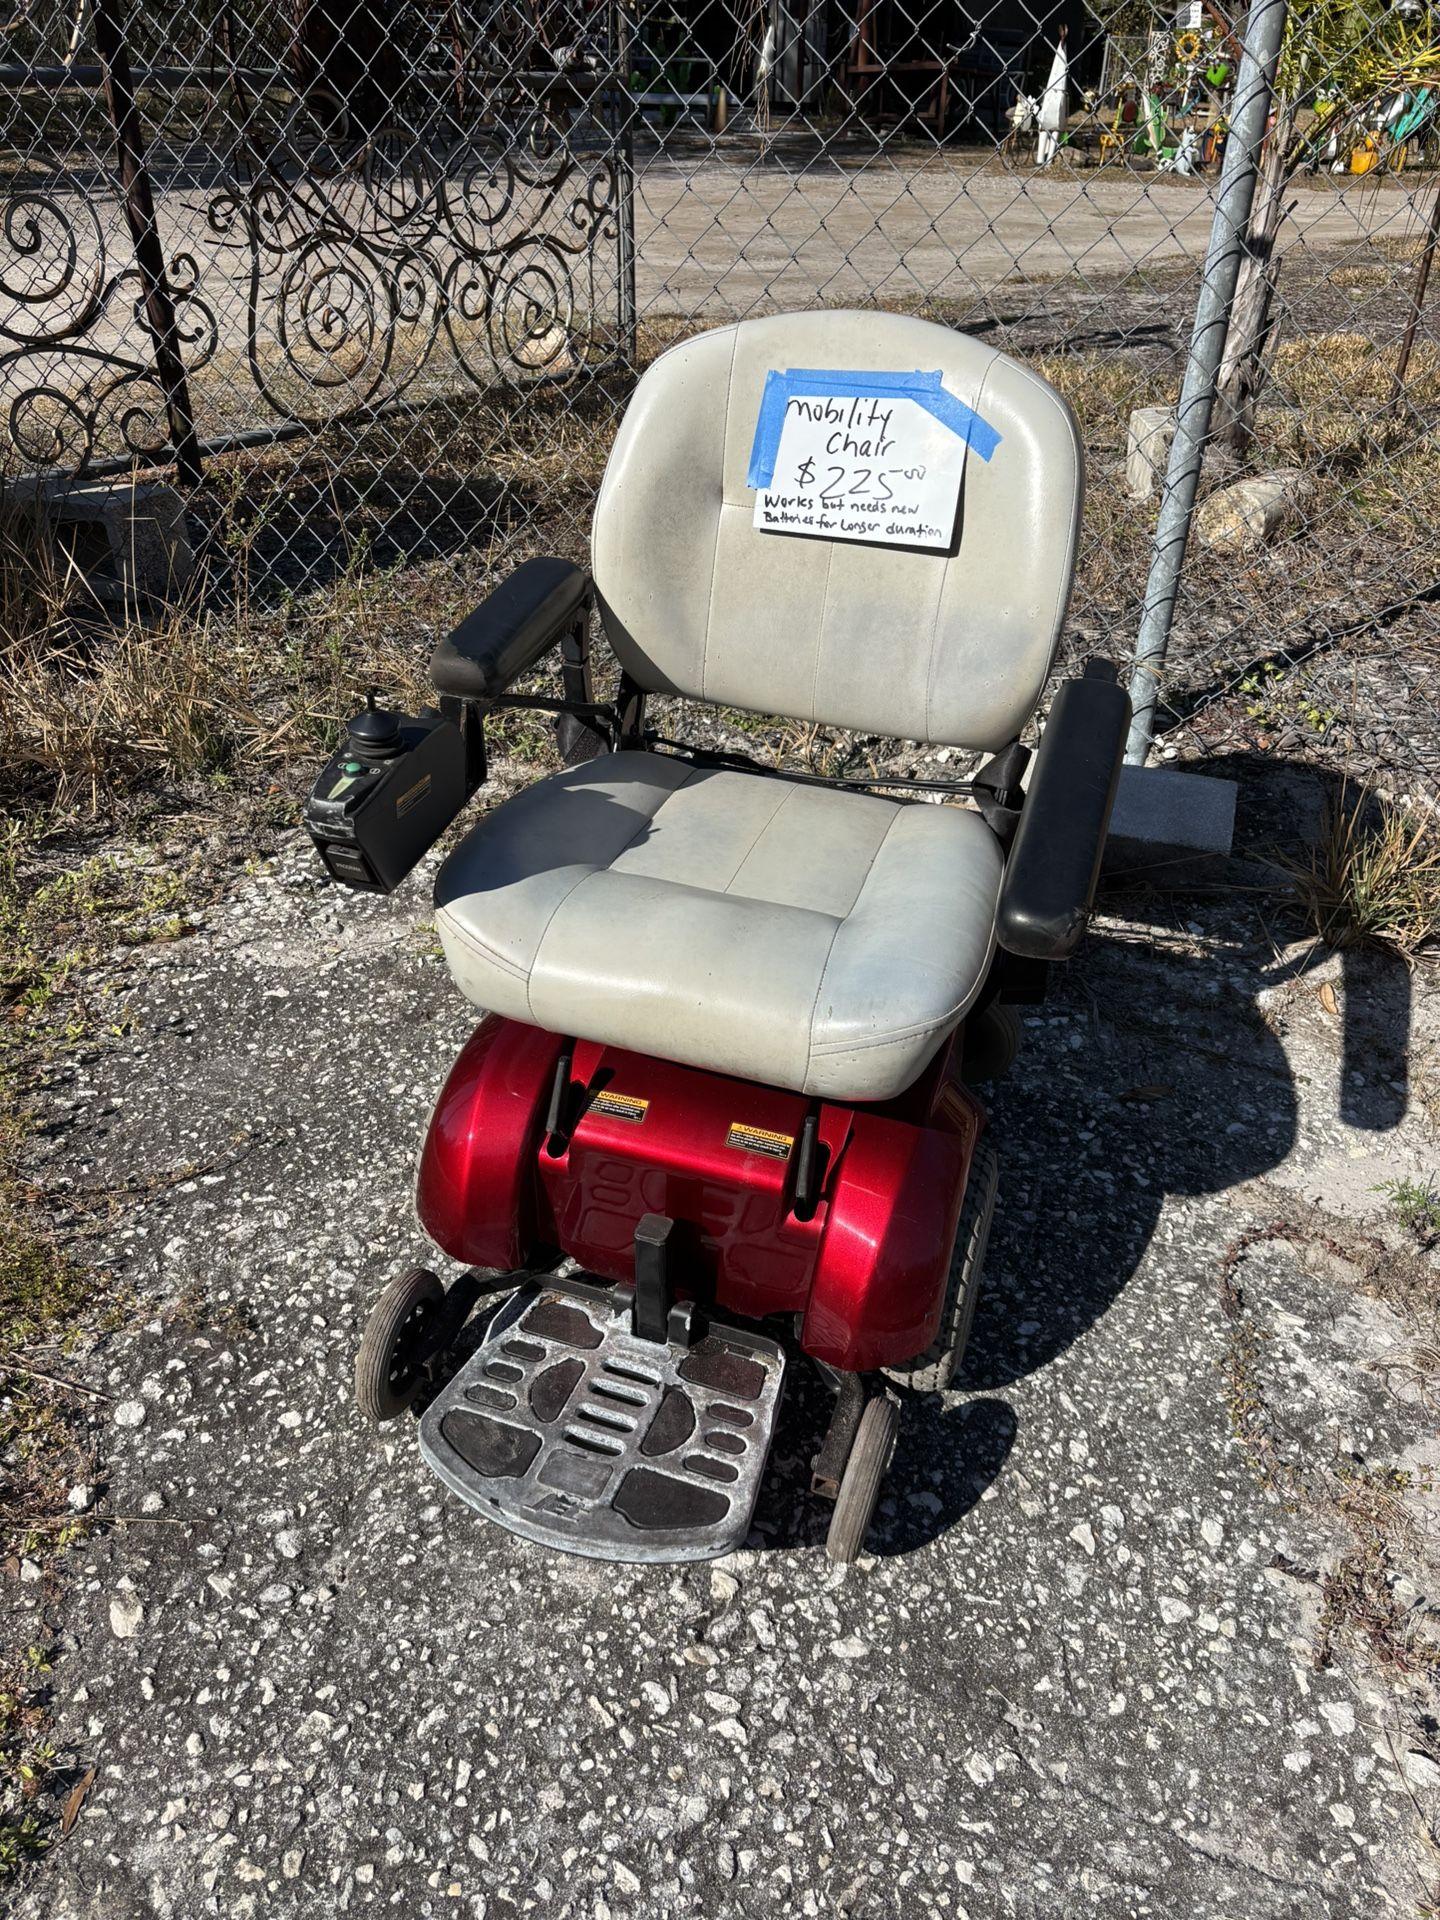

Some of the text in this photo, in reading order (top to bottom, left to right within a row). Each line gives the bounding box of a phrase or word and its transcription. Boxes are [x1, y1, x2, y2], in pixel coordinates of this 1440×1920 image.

[826, 432, 896, 457] Chair
[764, 494, 919, 515] Works but needs new
[816, 513, 837, 529] for
[885, 522, 942, 538] duration
[600, 1092, 642, 1105] WARNING
[743, 1126, 787, 1141] WARNING
